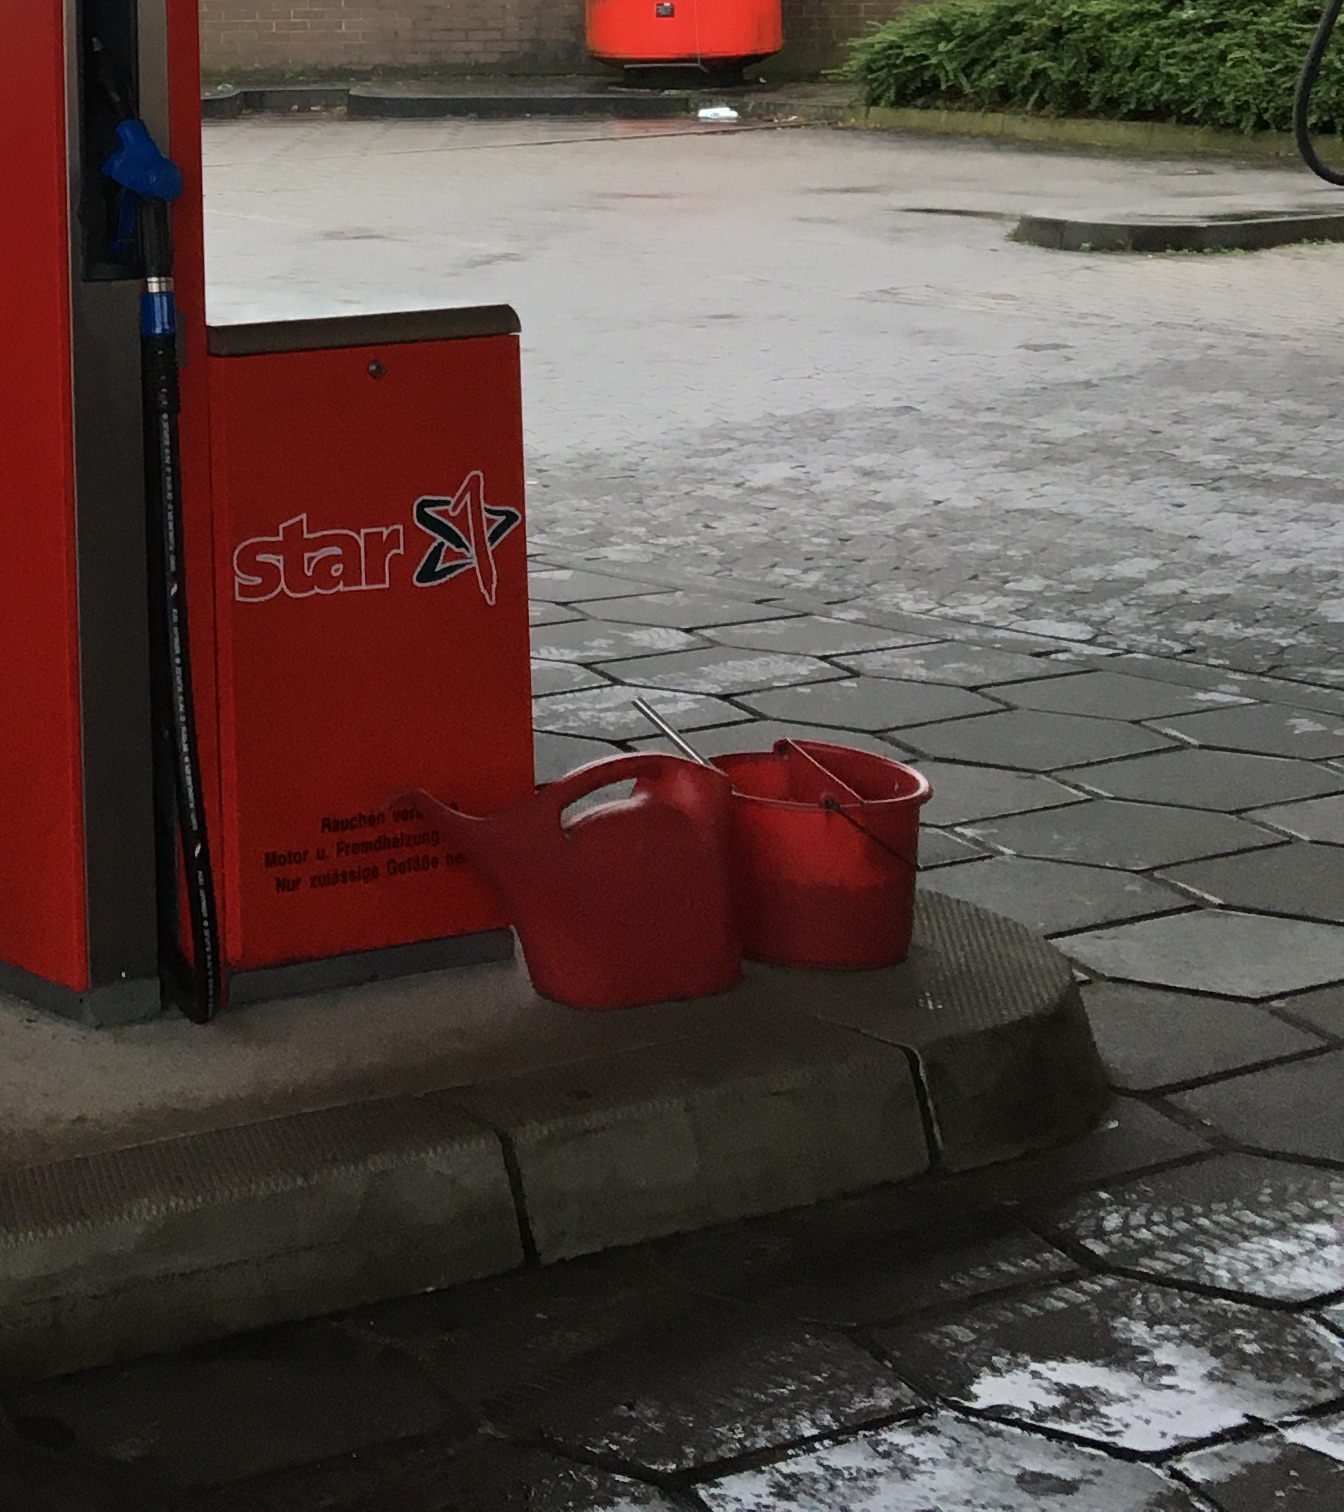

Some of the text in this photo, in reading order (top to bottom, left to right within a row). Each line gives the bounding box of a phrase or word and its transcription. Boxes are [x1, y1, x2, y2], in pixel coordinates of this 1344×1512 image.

[233, 512, 405, 603] star
[320, 811, 386, 834] Rauchen
[263, 849, 310, 870] Motor
[315, 846, 330, 861] u.
[335, 829, 441, 859] Fremdheizung
[274, 876, 302, 894] Nur
[309, 863, 381, 889] zulässige
